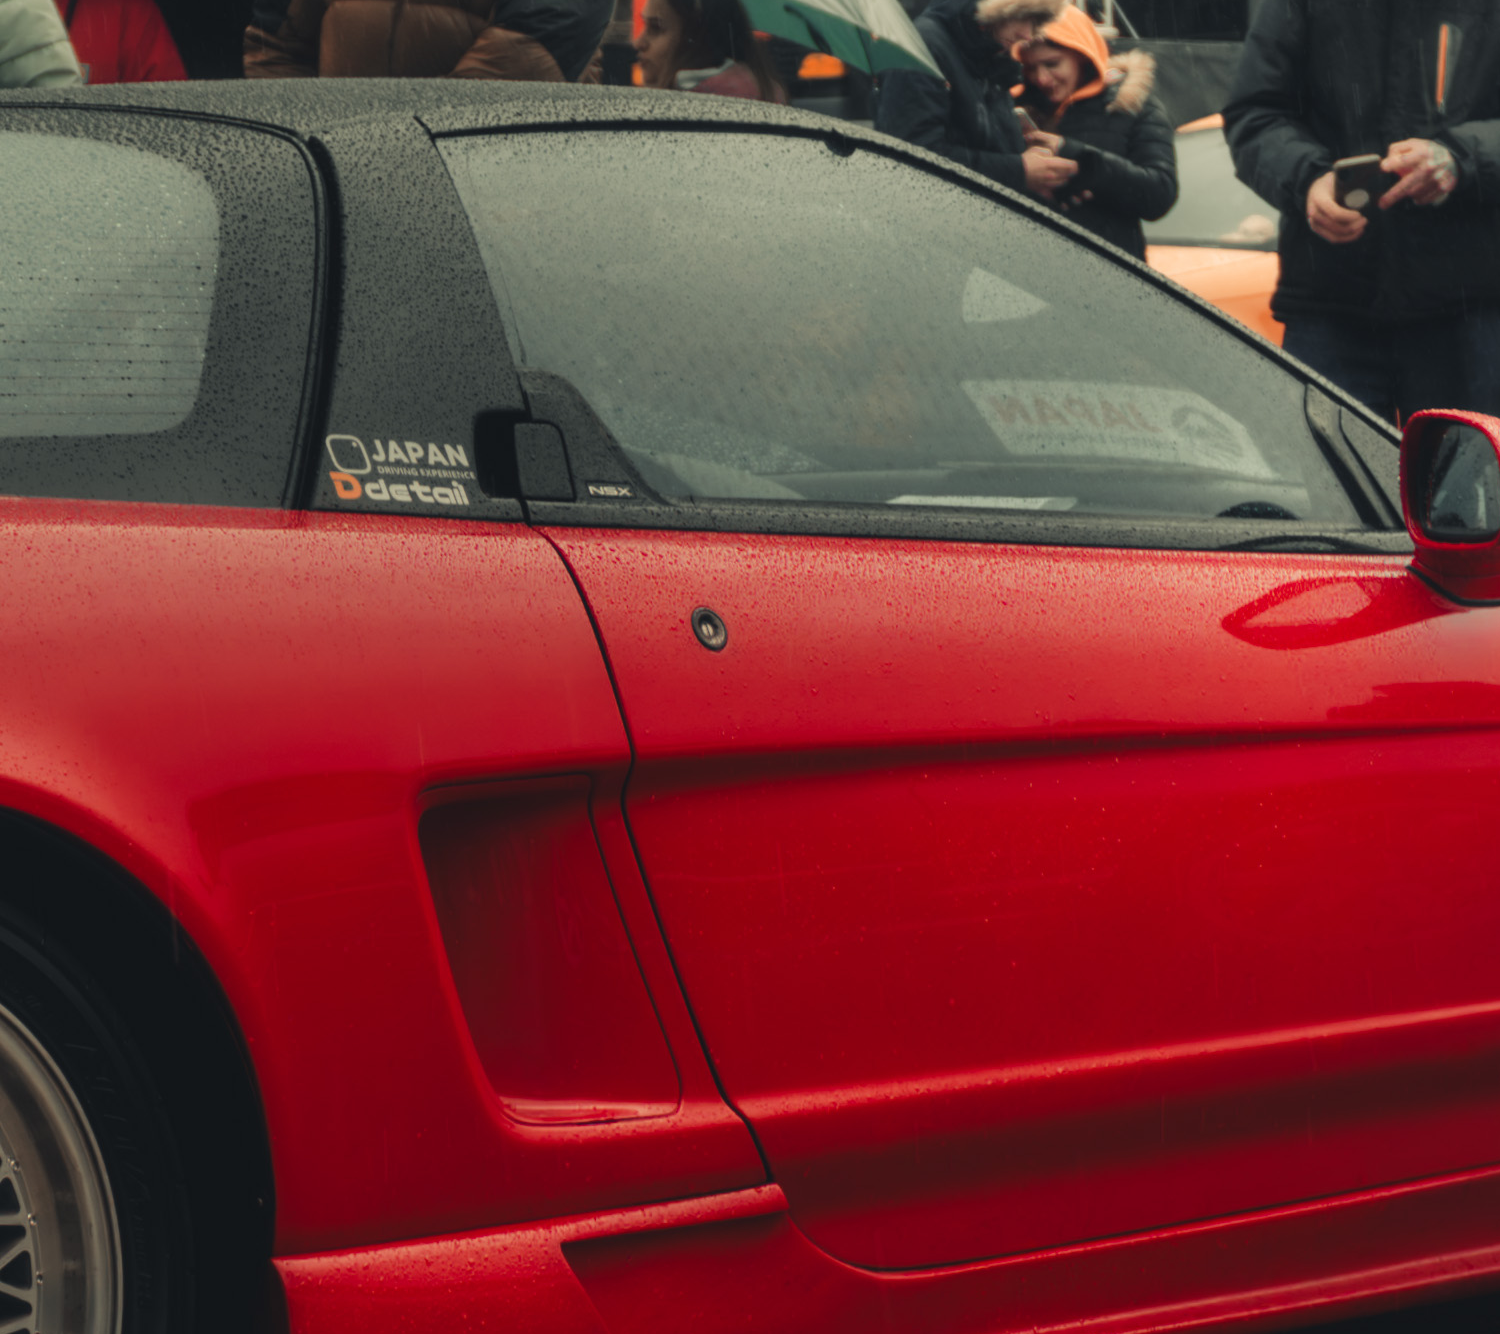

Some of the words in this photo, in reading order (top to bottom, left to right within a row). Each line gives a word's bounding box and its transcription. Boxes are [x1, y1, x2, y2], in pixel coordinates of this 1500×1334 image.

[371, 439, 470, 468] JAPAN
[376, 465, 418, 478] DRIVING
[419, 468, 477, 481] EXPERIENCE
[588, 485, 633, 497] NSX
